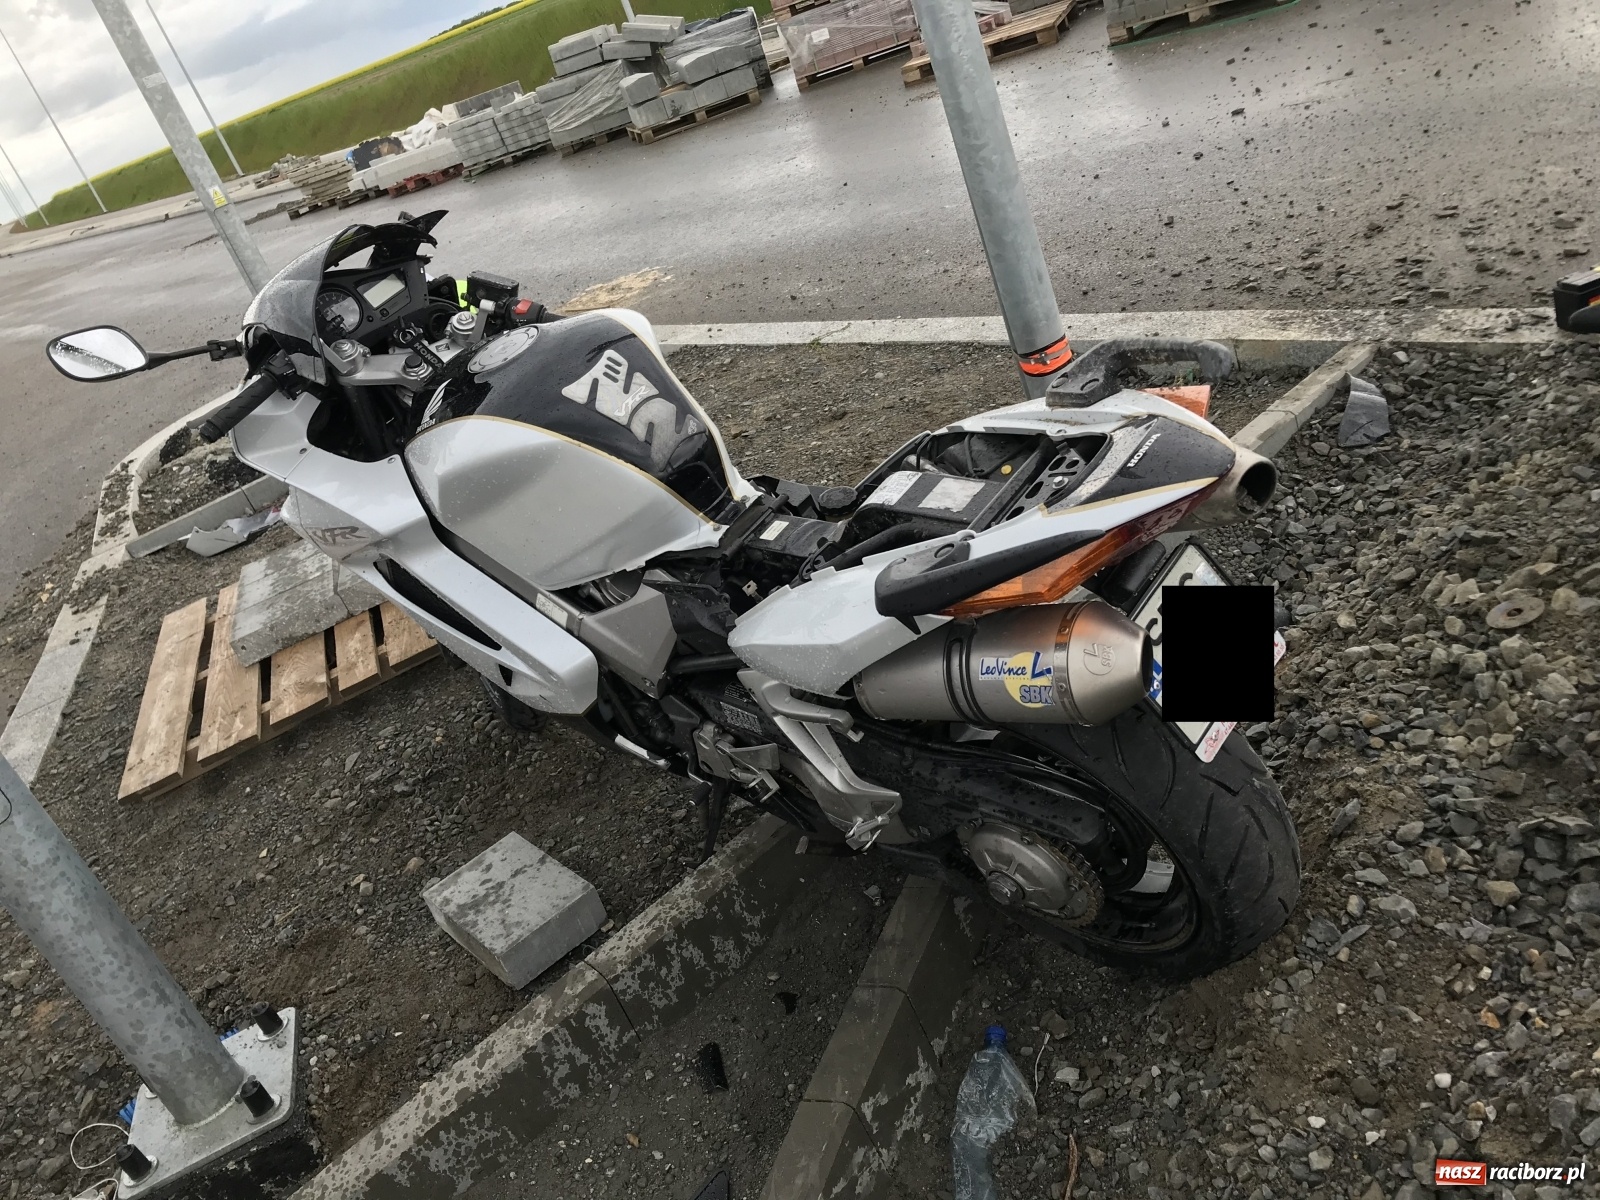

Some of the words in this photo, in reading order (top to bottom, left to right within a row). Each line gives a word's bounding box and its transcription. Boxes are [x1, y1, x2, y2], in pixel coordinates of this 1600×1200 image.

[1127, 433, 1161, 468] HONDA
[980, 658, 1027, 676] LeoVince
[1019, 685, 1053, 705] SBK
